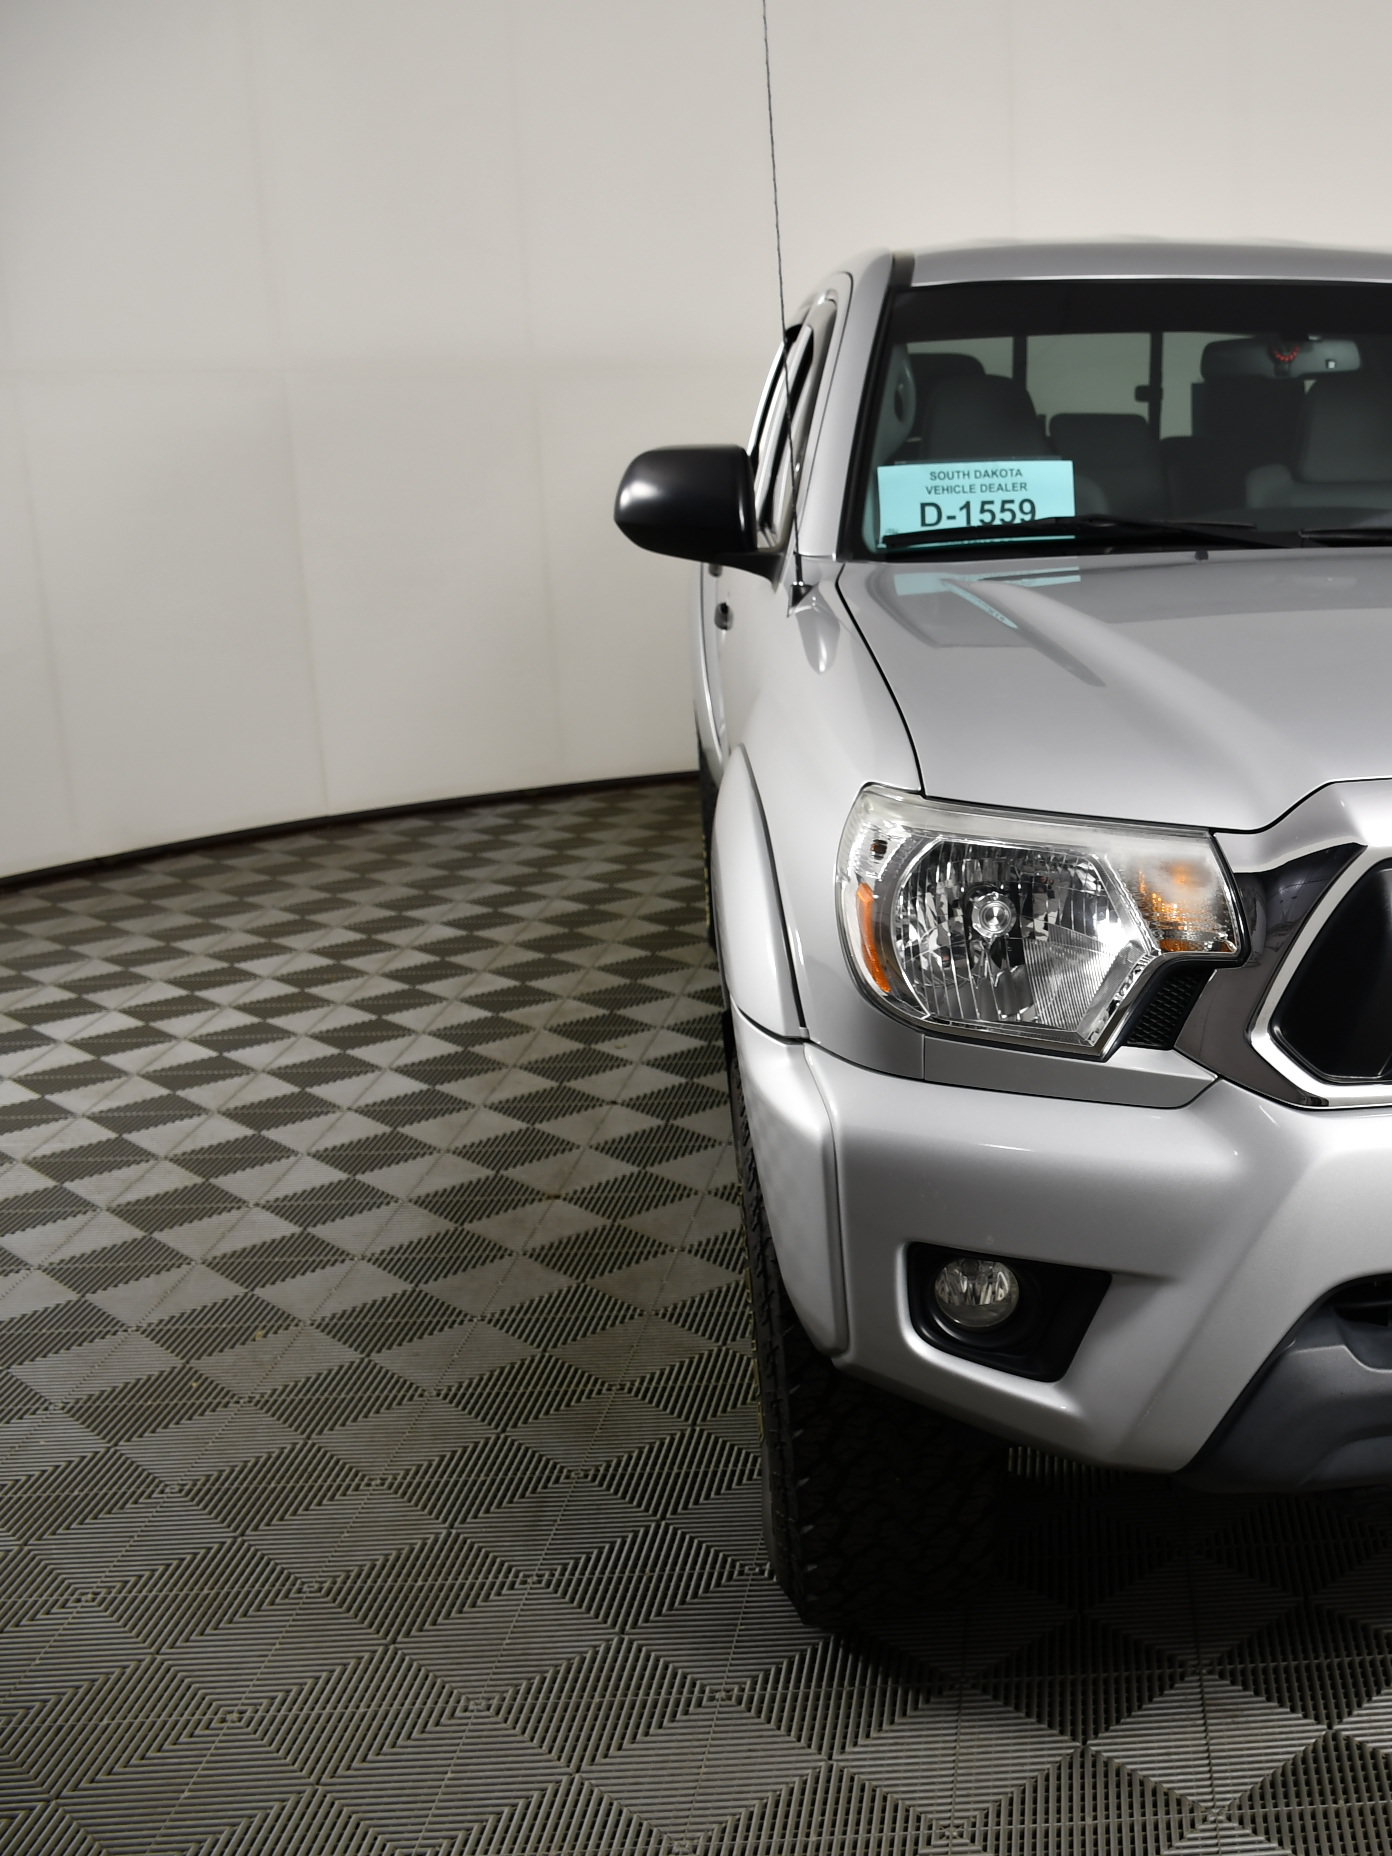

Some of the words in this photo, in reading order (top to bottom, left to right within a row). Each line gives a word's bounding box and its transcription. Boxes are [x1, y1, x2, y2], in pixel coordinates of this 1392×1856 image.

[929, 470, 970, 481] SOUTH
[974, 468, 1023, 479] DAKOTA
[925, 483, 976, 495] VEHICLE
[980, 482, 1028, 494] DEALER
[920, 498, 1036, 527] D-1559
